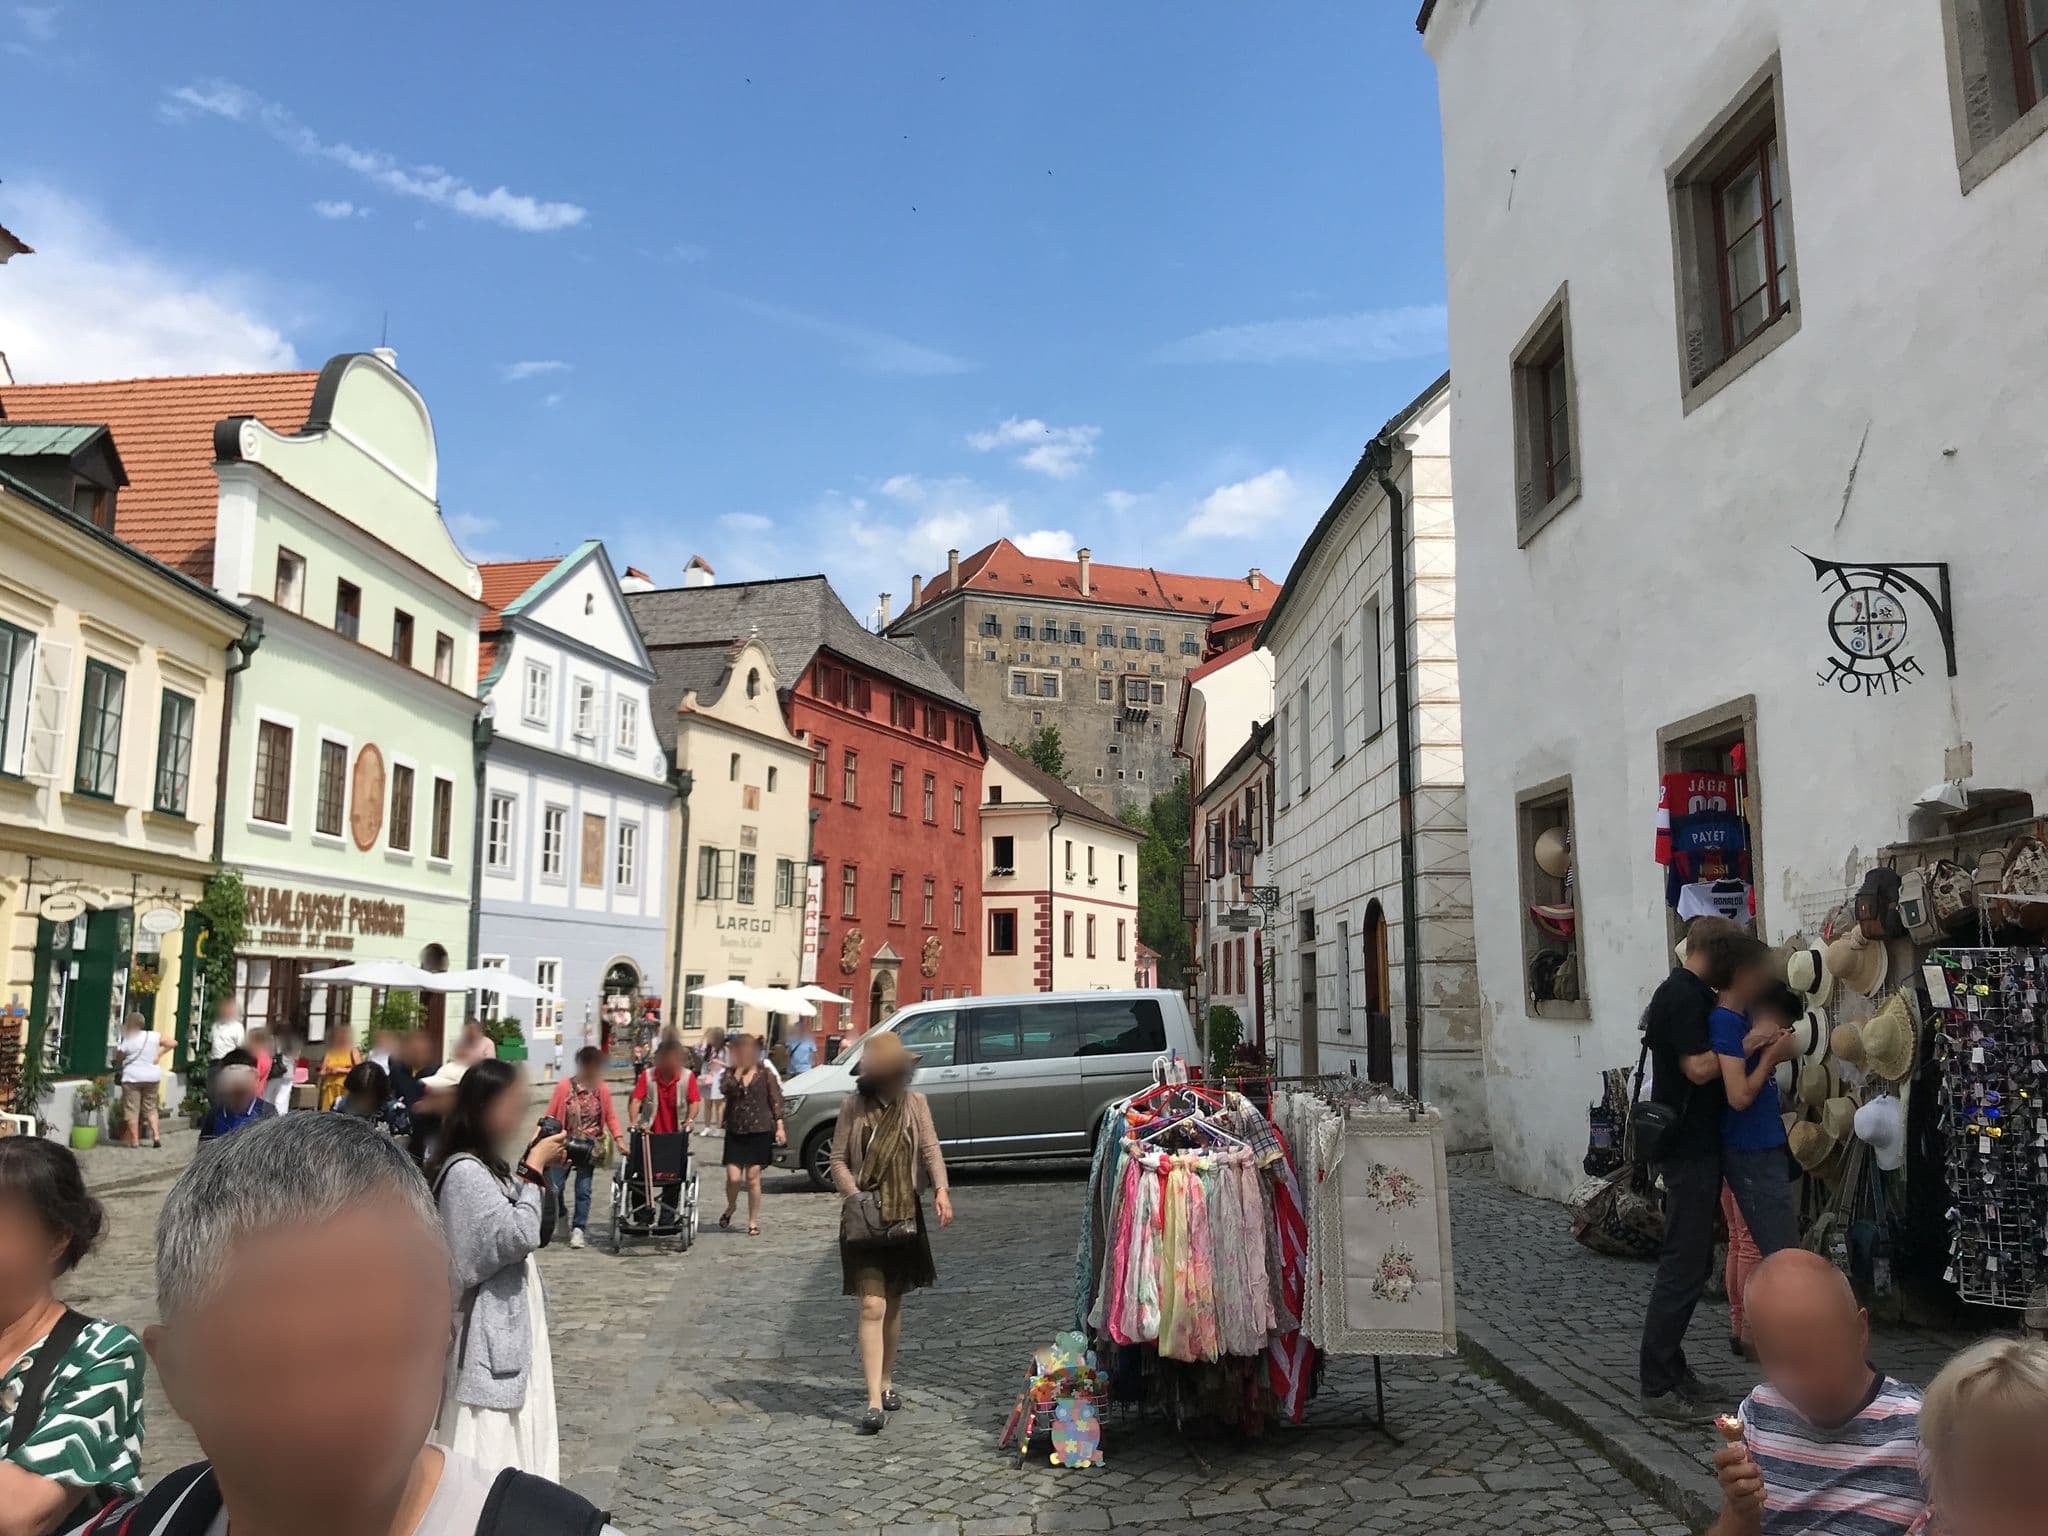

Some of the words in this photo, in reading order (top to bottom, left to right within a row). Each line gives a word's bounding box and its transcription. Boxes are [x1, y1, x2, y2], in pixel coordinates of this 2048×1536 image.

[1688, 777, 1726, 792] JÁGR
[1691, 830, 1726, 844] PAYET
[1699, 864, 1729, 875] SSI
[244, 884, 346, 932] RUMLOVSKÁ
[804, 878, 818, 953] LARGO
[716, 915, 771, 932] LARGO
